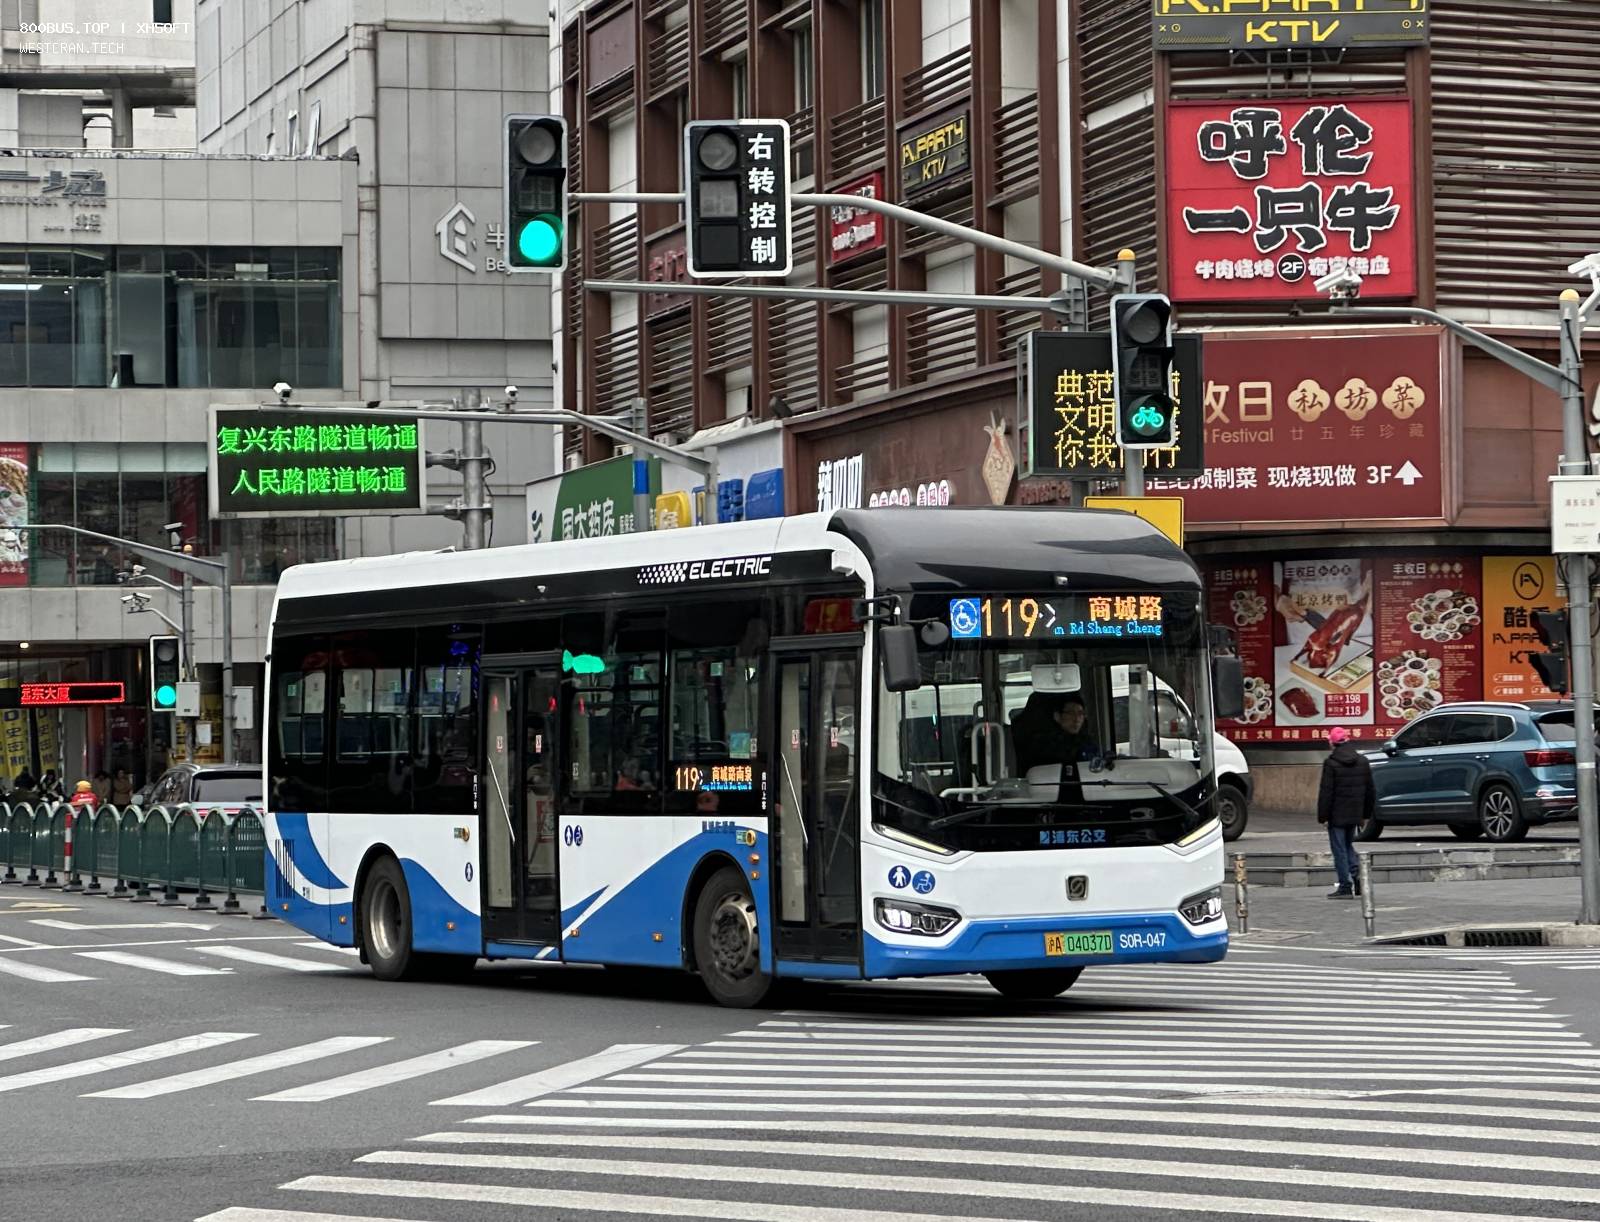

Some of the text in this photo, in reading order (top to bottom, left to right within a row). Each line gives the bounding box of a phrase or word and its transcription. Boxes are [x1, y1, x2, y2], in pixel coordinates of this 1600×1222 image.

[1246, 19, 1340, 43] KTV
[1197, 104, 1373, 180] 呼伦
[922, 156, 946, 182] KTV
[747, 132, 777, 264] 右转控制
[1182, 181, 1400, 253] 一只牛
[486, 257, 512, 276] Be
[1281, 261, 1304, 275] 2F
[1054, 369, 1181, 404] 典范
[1054, 402, 1181, 440] 文明
[1289, 423, 1425, 441] 廿五年珍藏
[217, 424, 419, 454] 复兴东路隧道畅通
[1212, 427, 1274, 443] Festival
[231, 466, 407, 495] 人民路隧道畅通
[1267, 464, 1357, 488] 现烧现做
[1366, 465, 1392, 485] 3F
[688, 556, 772, 580] ELECTRIC
[981, 595, 1163, 637] 119 商城路
[1070, 622, 1084, 635] Rd
[1127, 619, 1163, 636] Cheng
[1345, 694, 1361, 704] 198
[1345, 706, 1361, 716] 118
[1374, 728, 1395, 738] 公正
[676, 767, 698, 791] 119
[1052, 829, 1106, 844] 浦东公交
[1067, 934, 1112, 952] 04037D
